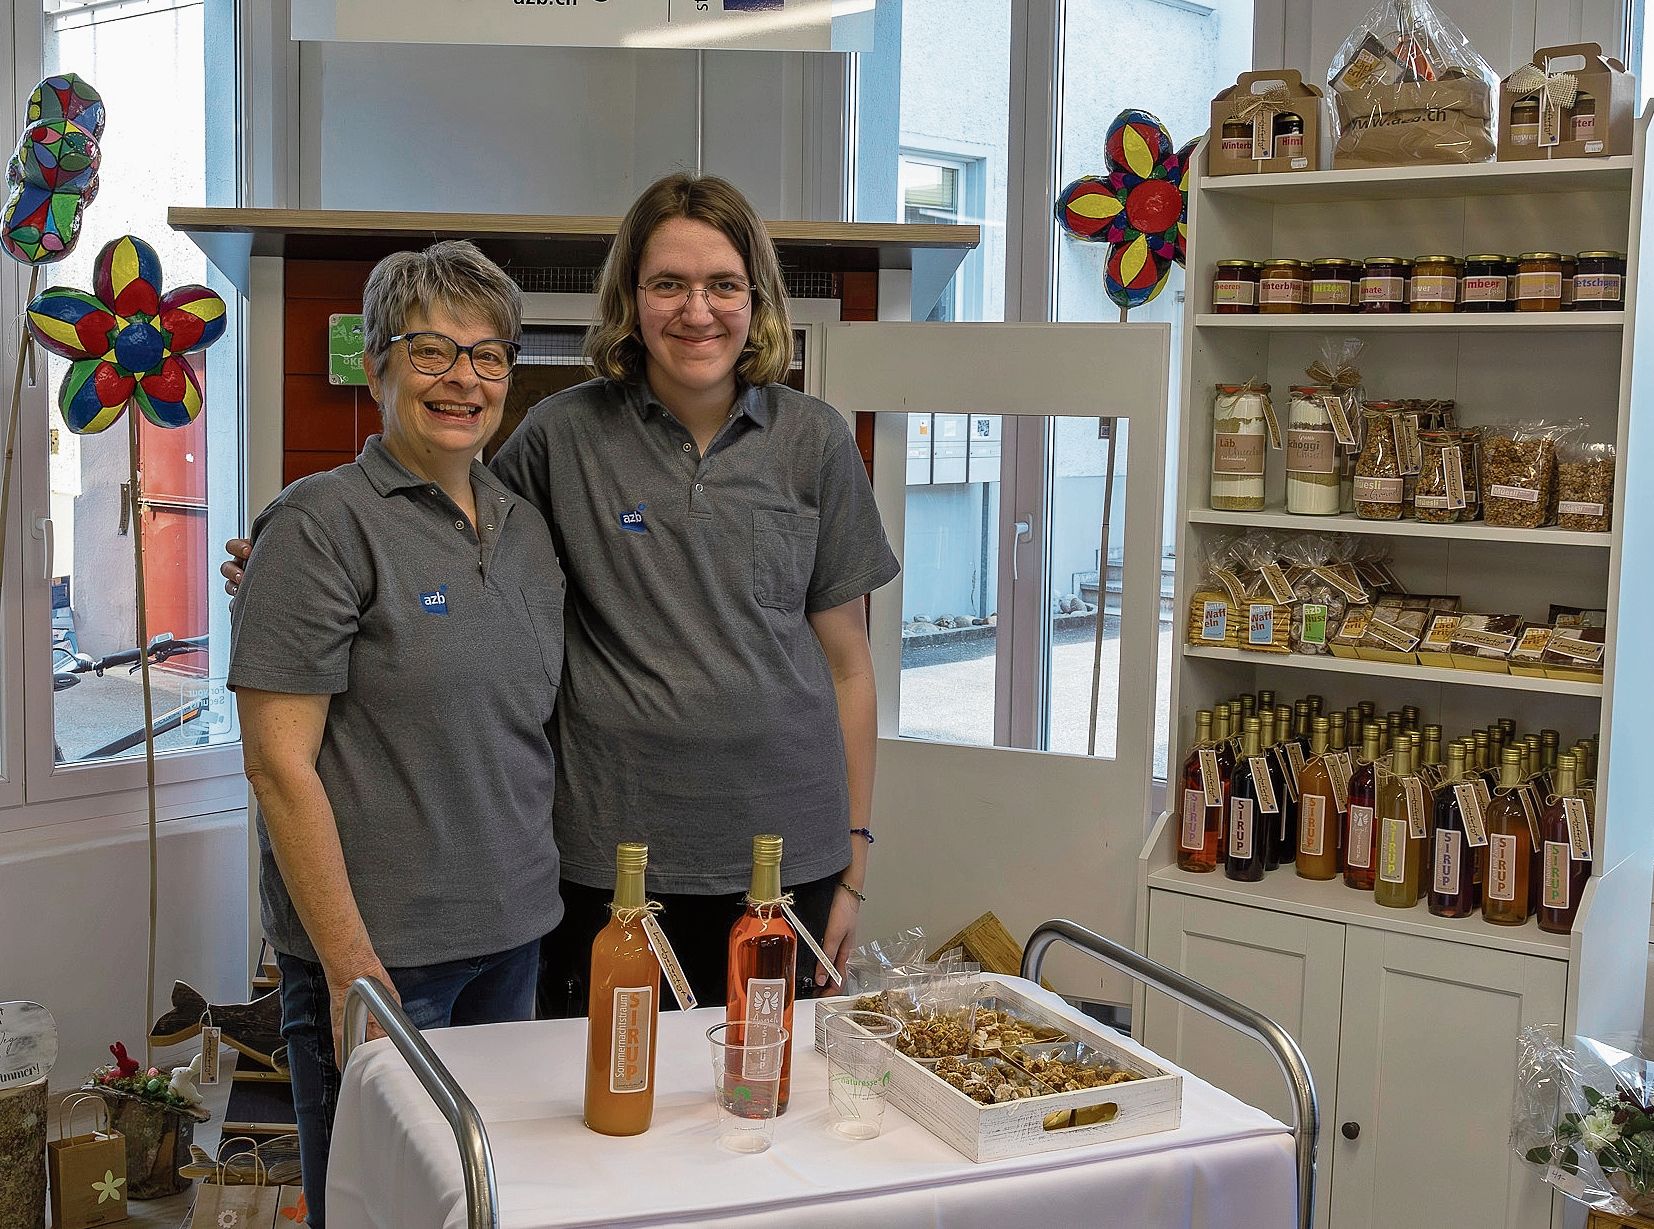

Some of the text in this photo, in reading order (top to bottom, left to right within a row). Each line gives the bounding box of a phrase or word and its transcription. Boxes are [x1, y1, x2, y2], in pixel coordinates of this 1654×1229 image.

[623, 511, 642, 523] azb
[424, 592, 446, 606] azb
[1205, 608, 1226, 619] Waff
[1250, 610, 1272, 622] Waff
[1304, 607, 1322, 615] azb
[1204, 619, 1219, 628] eln
[1250, 622, 1265, 632] eln
[1236, 800, 1245, 851] SIRUP
[1306, 797, 1316, 848] SIRUP
[1442, 832, 1452, 886] SIRUP
[1497, 838, 1507, 892] SIRUP
[1551, 845, 1560, 900] SIRUP
[615, 994, 629, 1078] Sommernachtstraum
[625, 993, 640, 1080] SIRUP
[841, 1077, 878, 1087] naturesse
